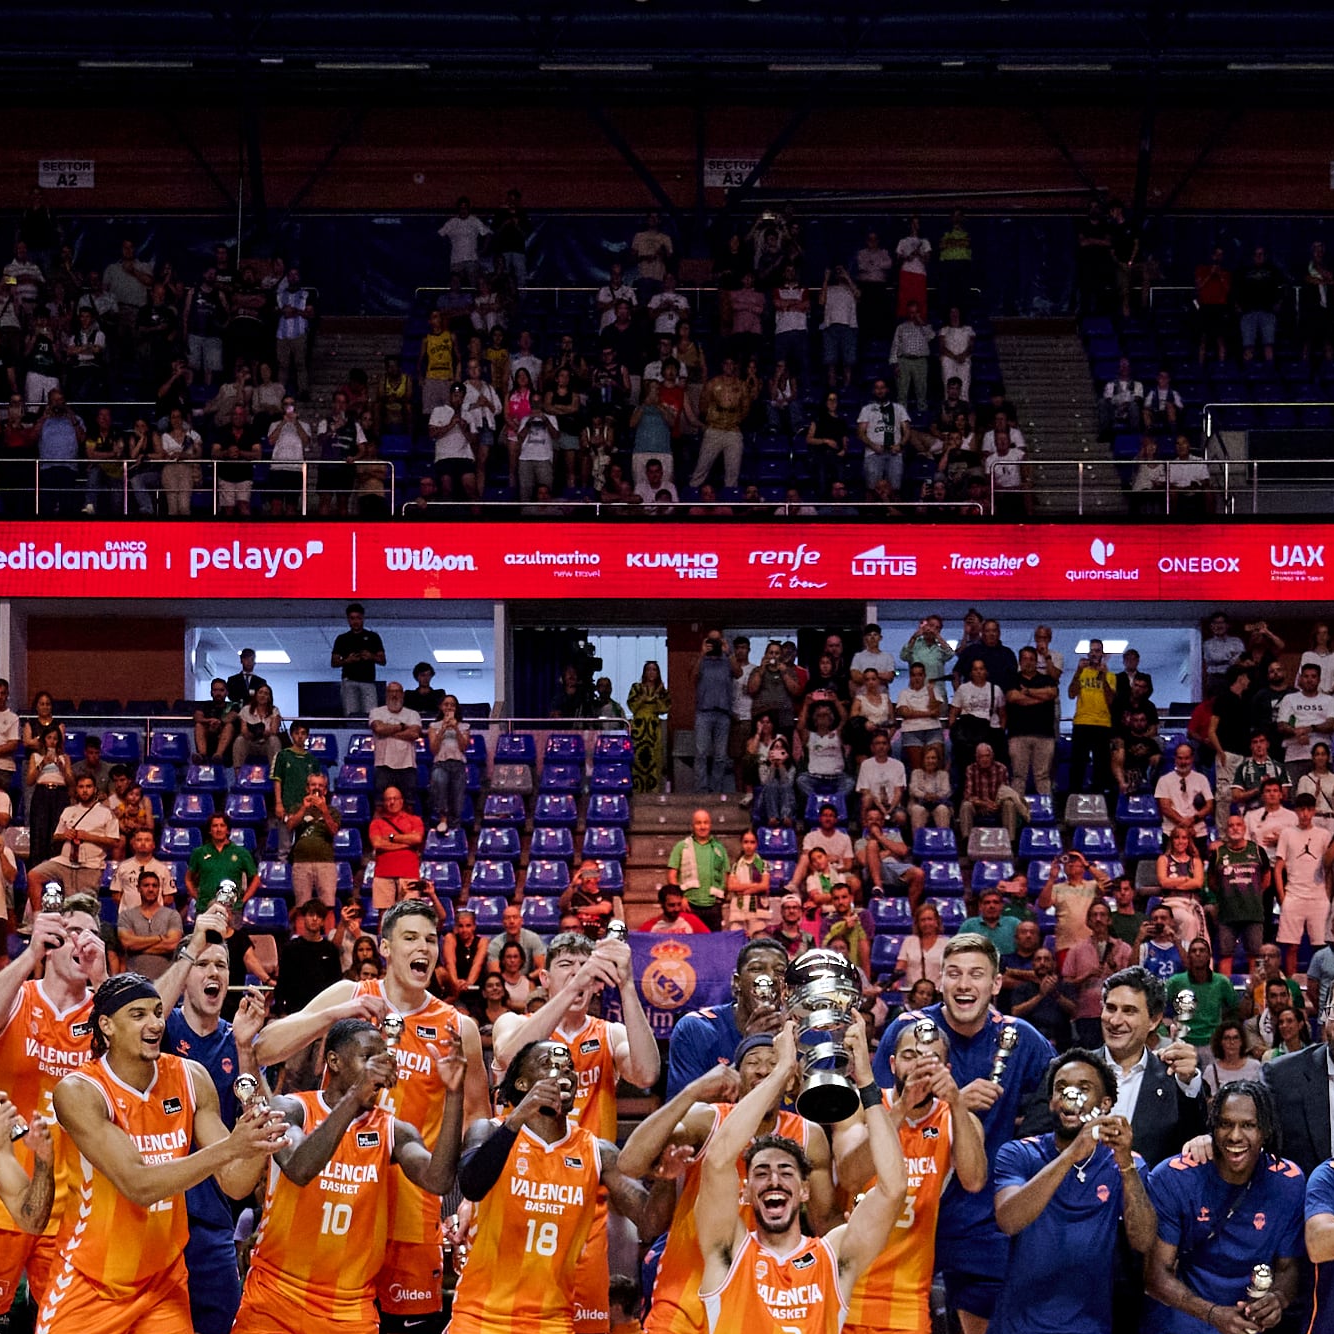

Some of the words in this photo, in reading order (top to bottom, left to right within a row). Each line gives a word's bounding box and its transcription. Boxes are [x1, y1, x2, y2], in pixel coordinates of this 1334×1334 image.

[57, 174, 77, 186] A2
[723, 173, 742, 185] A3
[106, 542, 146, 550] BANCO
[190, 541, 302, 578] pelayo
[385, 547, 476, 571] Wilson
[504, 551, 600, 564] azulmarino
[627, 554, 718, 567] KUMHO
[749, 544, 820, 571] renfe
[950, 554, 1024, 569] Transaher
[1271, 546, 1324, 567] UAX
[852, 561, 916, 575] LOTUS
[1158, 558, 1239, 572] ONEBOX
[676, 569, 717, 578] TIRE
[320, 1179, 359, 1194] BASKET
[511, 1174, 583, 1207] VALENCIA
[525, 1199, 565, 1214] BASKET
[321, 1202, 352, 1234] 10
[526, 1219, 558, 1256] 18
